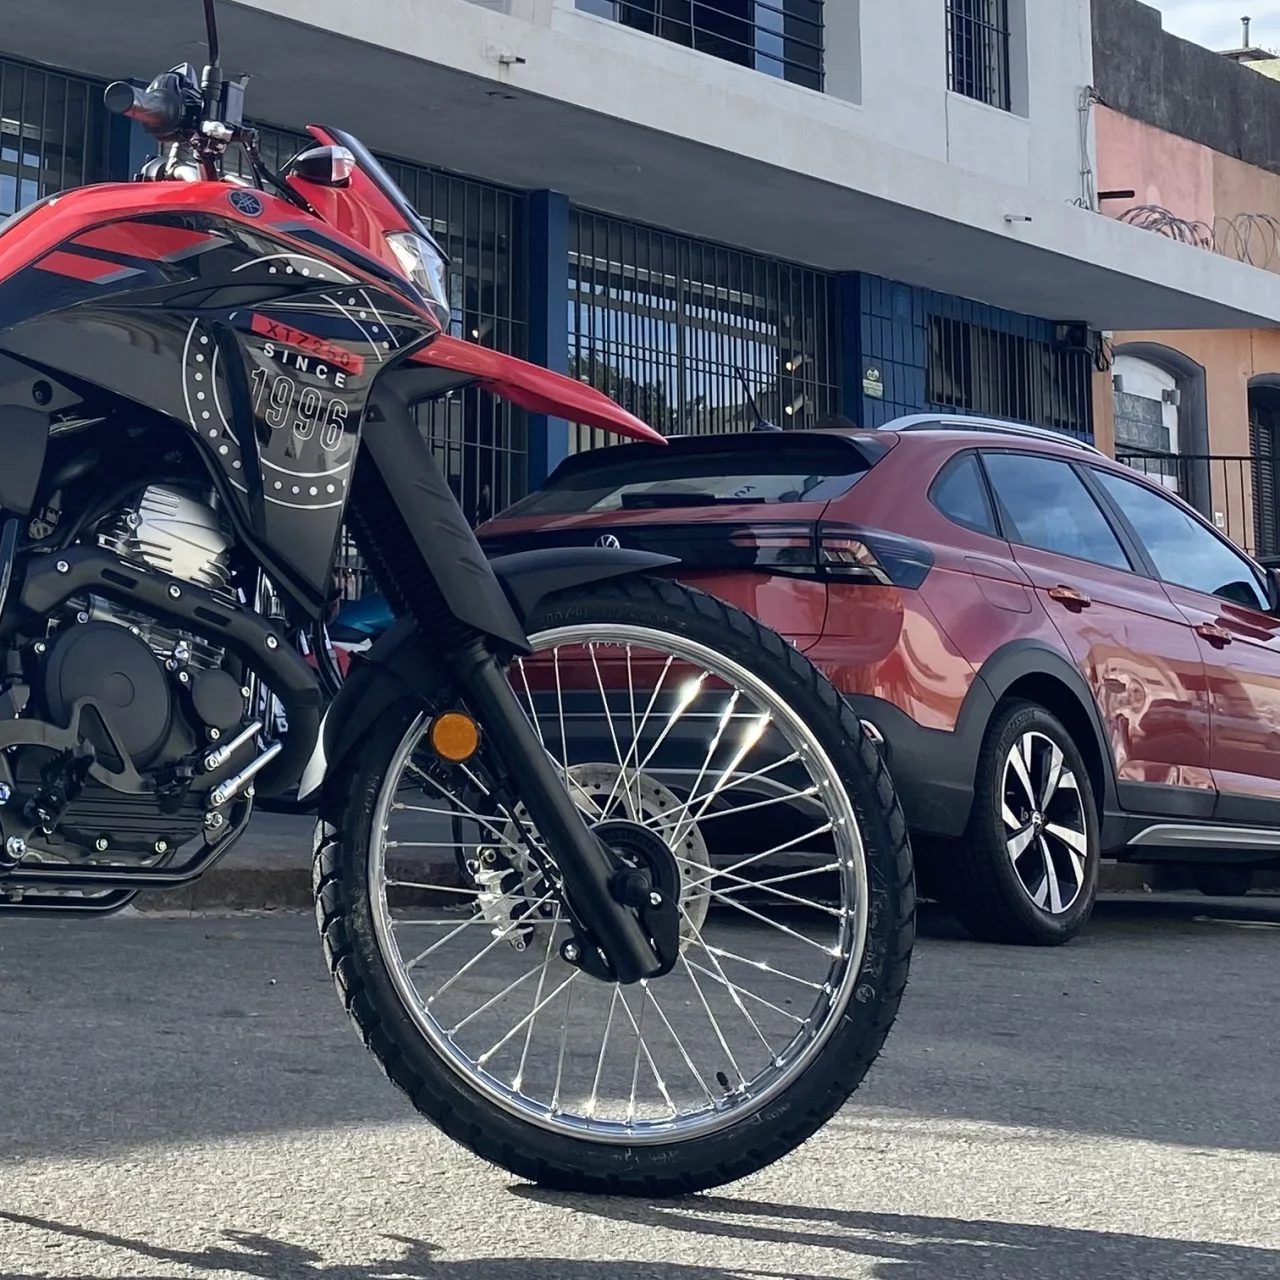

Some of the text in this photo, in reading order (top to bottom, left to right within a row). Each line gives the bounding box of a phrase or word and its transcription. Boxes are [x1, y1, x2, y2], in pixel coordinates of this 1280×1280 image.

[263, 342, 346, 389] SINCE
[266, 320, 351, 366] XTZ250
[251, 367, 348, 451] 1996
